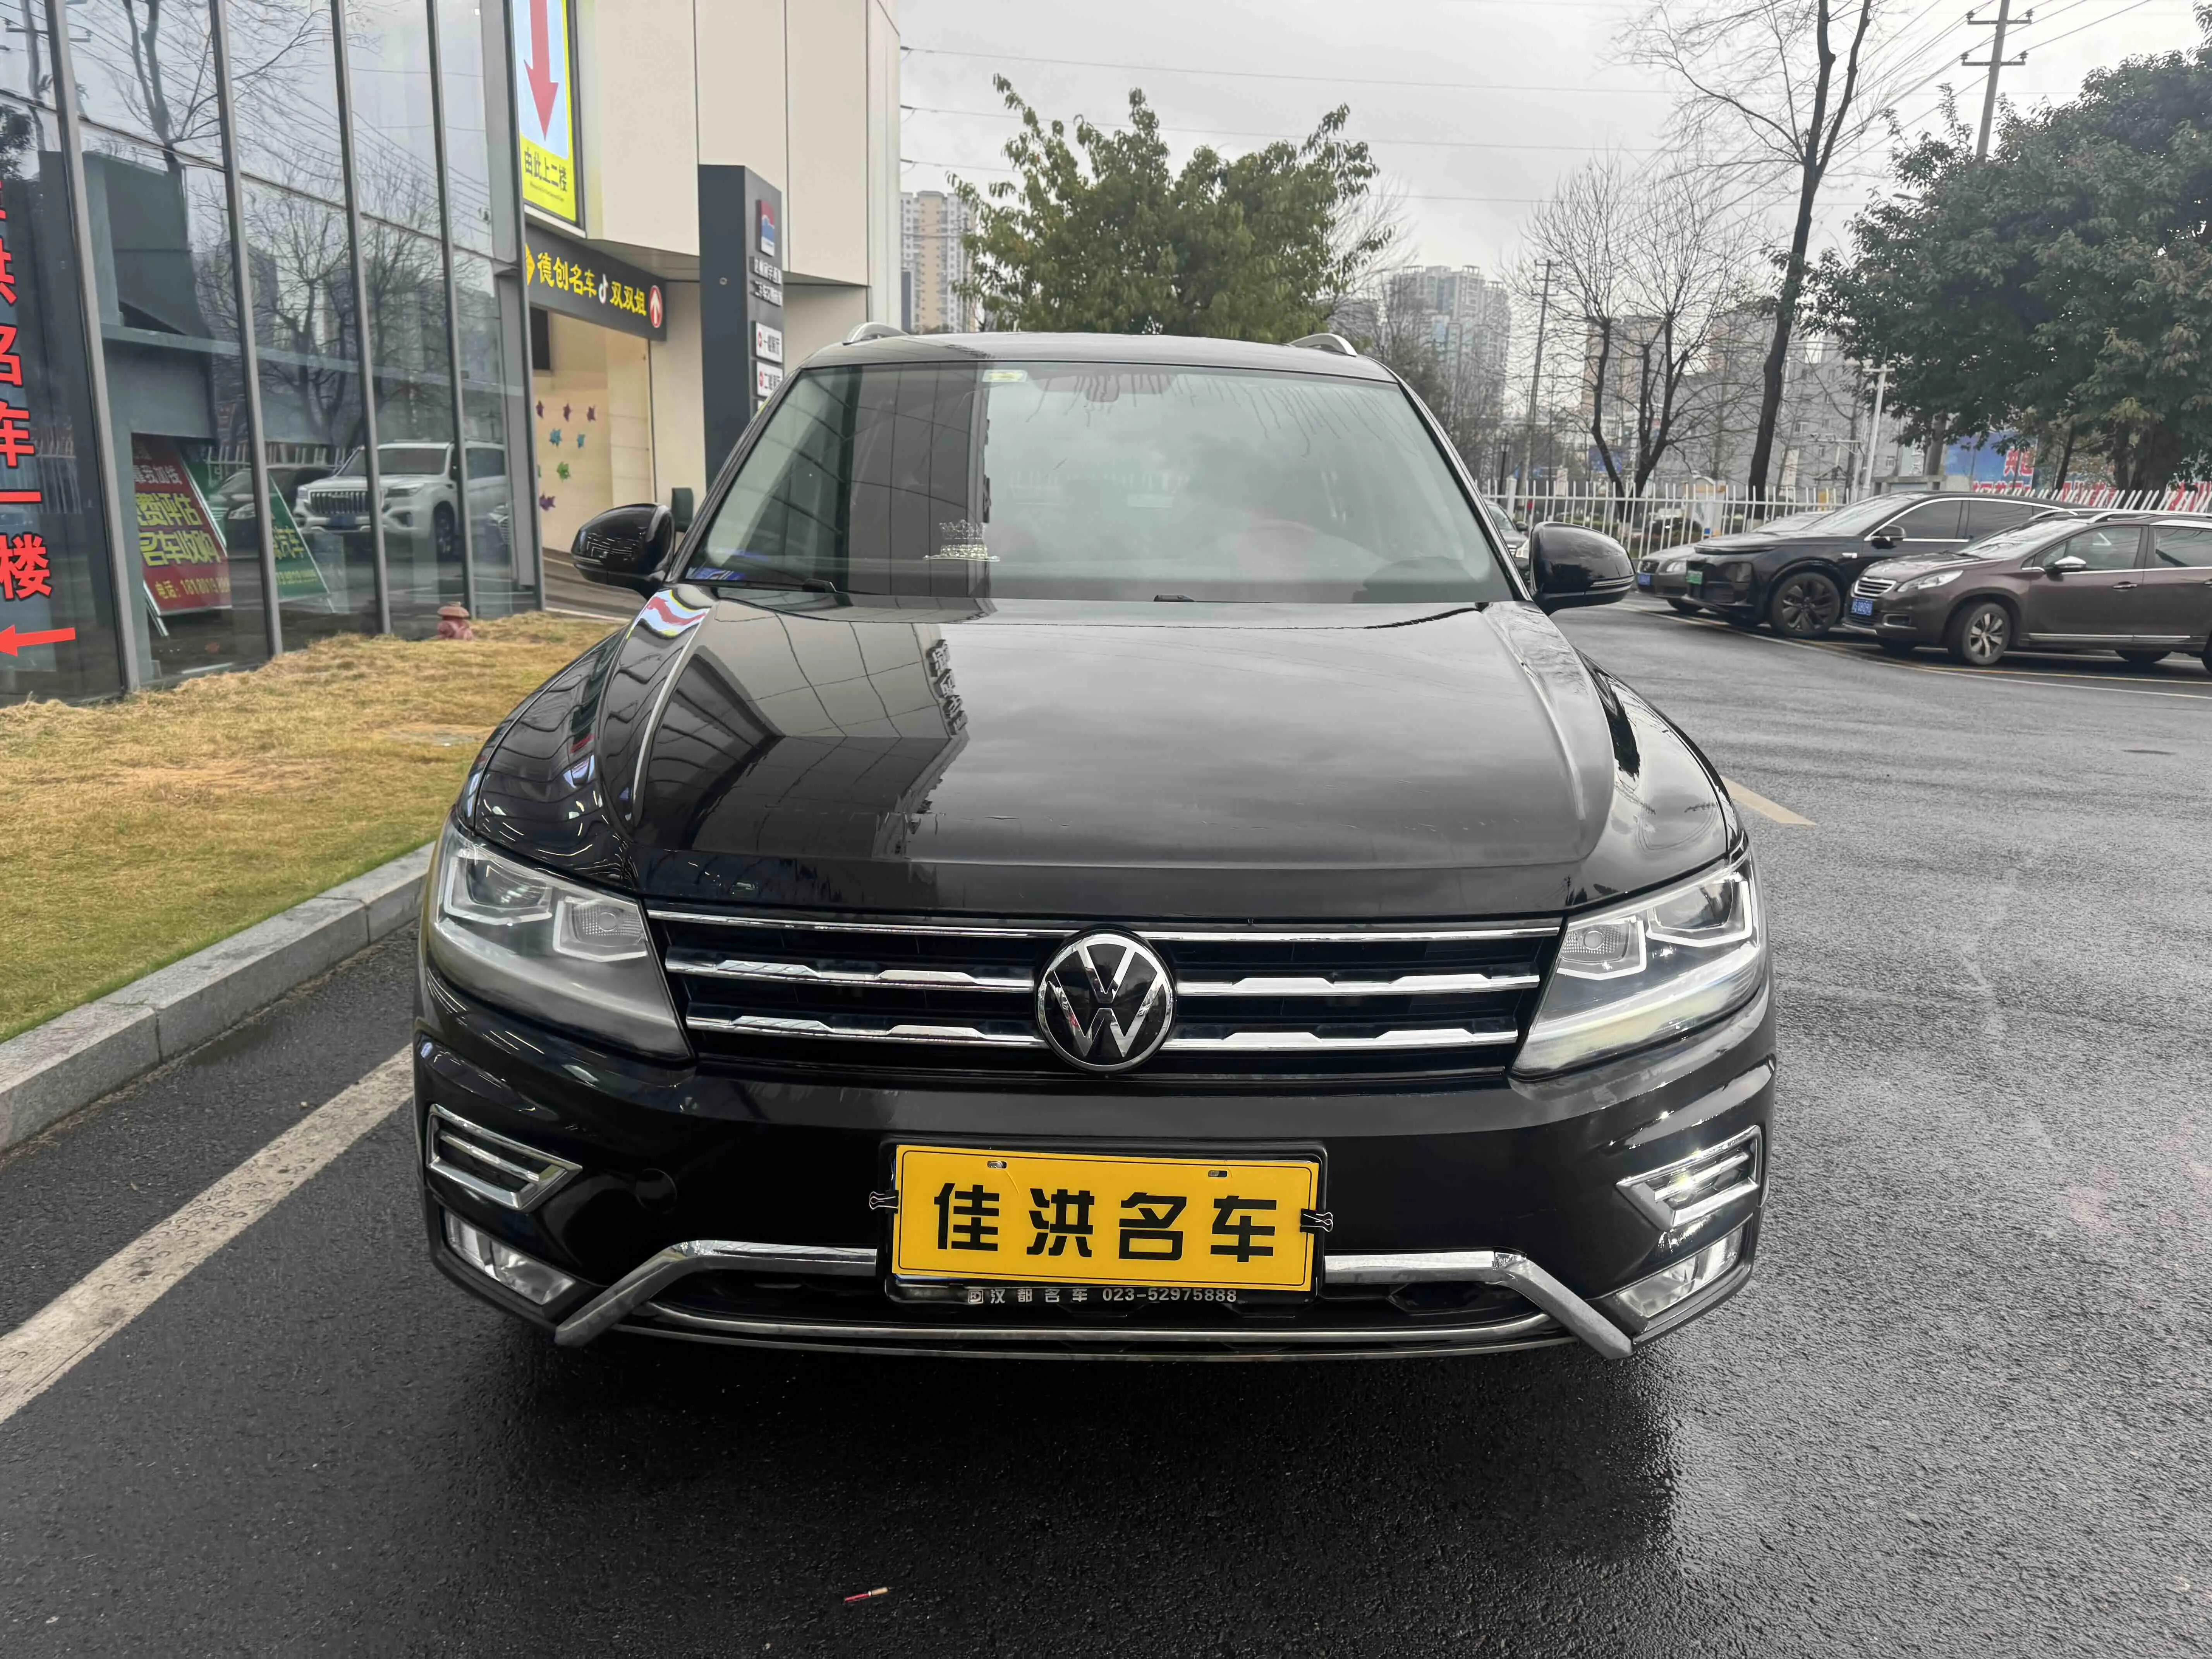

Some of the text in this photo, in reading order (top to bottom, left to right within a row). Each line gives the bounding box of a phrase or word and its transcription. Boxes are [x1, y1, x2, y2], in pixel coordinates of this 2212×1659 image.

[524, 146, 567, 192] 由此上二楼
[537, 252, 597, 298] 德创名车
[934, 1182, 1278, 1262] 佳洪名车
[1103, 1288, 1237, 1302] 023-52975888
